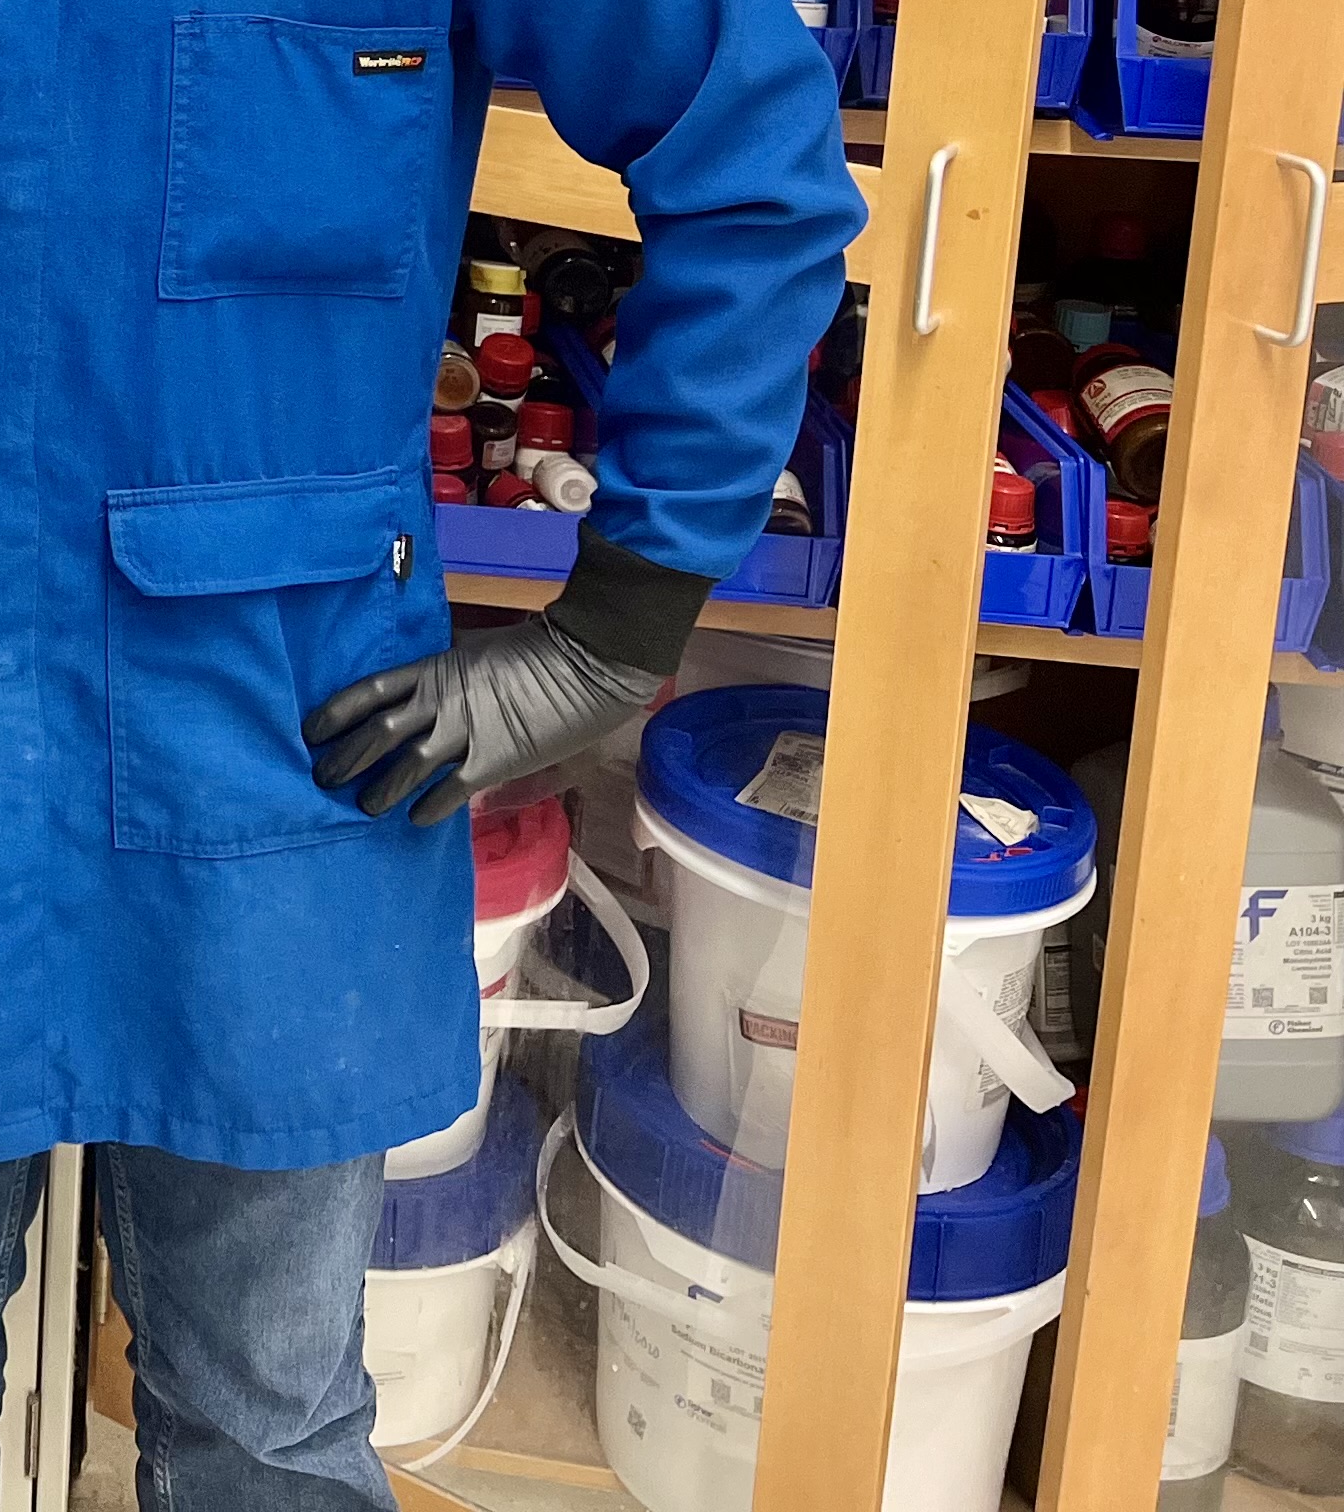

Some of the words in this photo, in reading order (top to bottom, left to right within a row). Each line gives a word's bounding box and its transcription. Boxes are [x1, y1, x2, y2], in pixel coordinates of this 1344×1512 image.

[1319, 914, 1331, 924] kg
[1289, 926, 1331, 937] A104-3
[671, 1324, 706, 1352] Sodium
